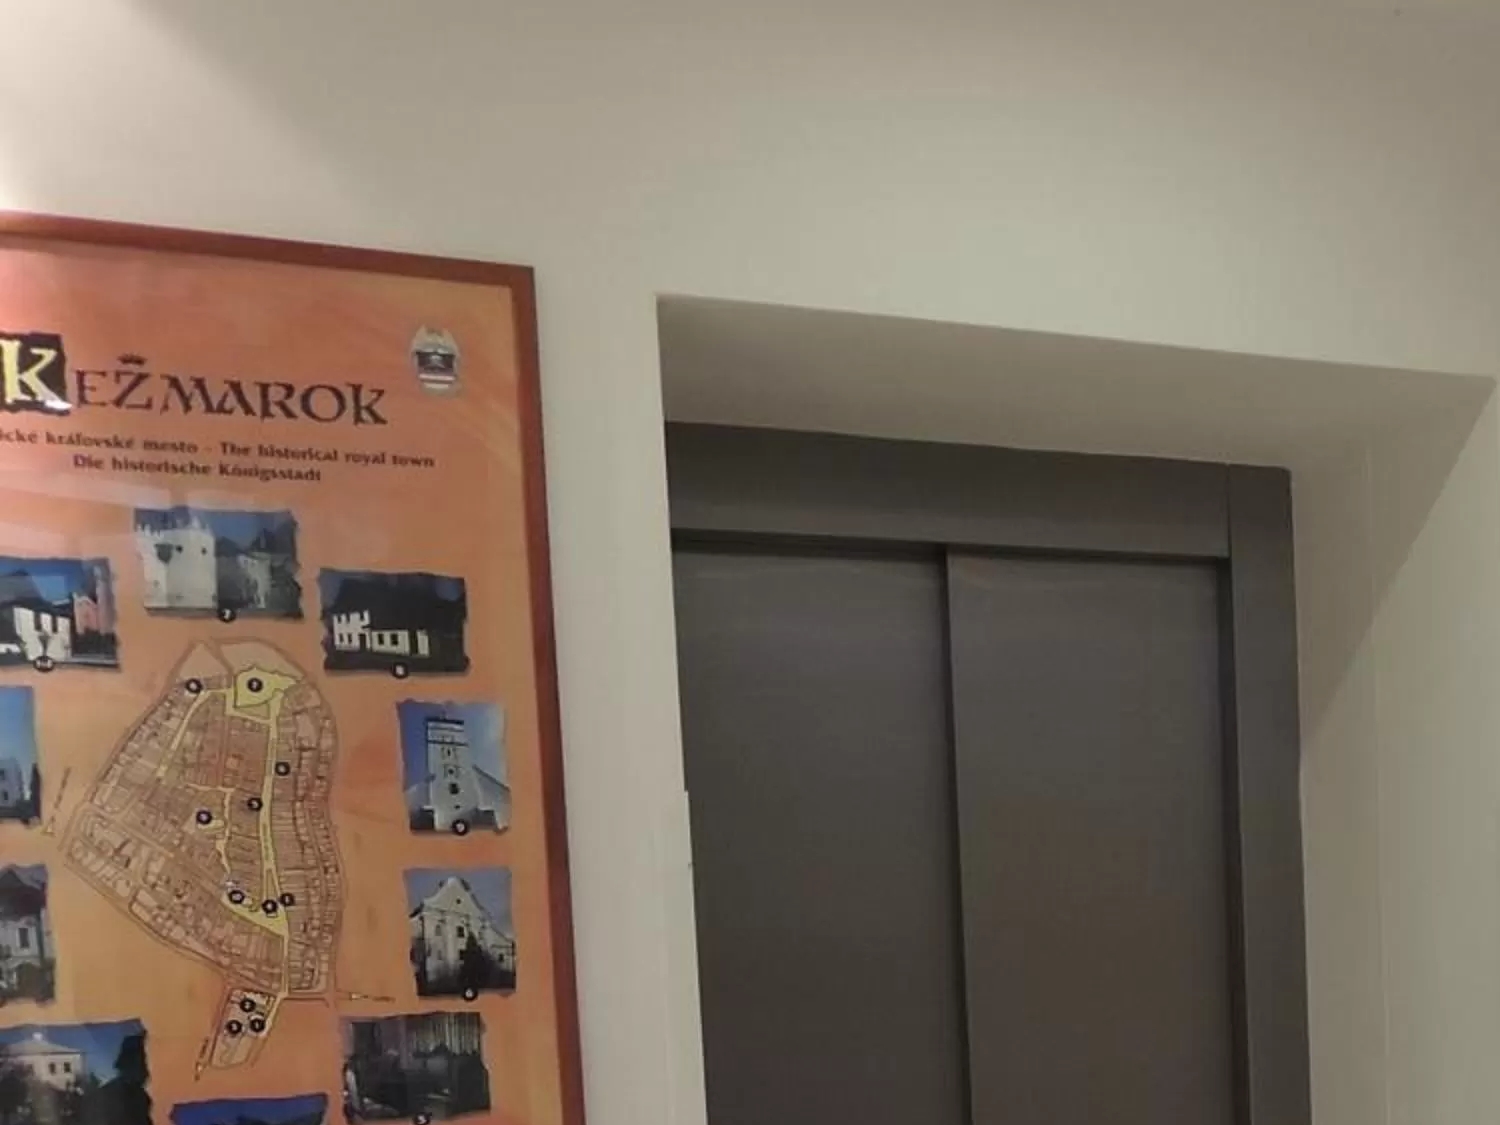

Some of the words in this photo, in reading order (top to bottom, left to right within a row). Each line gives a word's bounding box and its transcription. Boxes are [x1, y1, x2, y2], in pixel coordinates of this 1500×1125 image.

[73, 453, 103, 471] Die
[111, 456, 211, 476] historische
[143, 439, 199, 454] mesto
[220, 441, 250, 457] The
[257, 443, 339, 463] historical
[345, 452, 385, 468] royal
[391, 454, 435, 468] town
